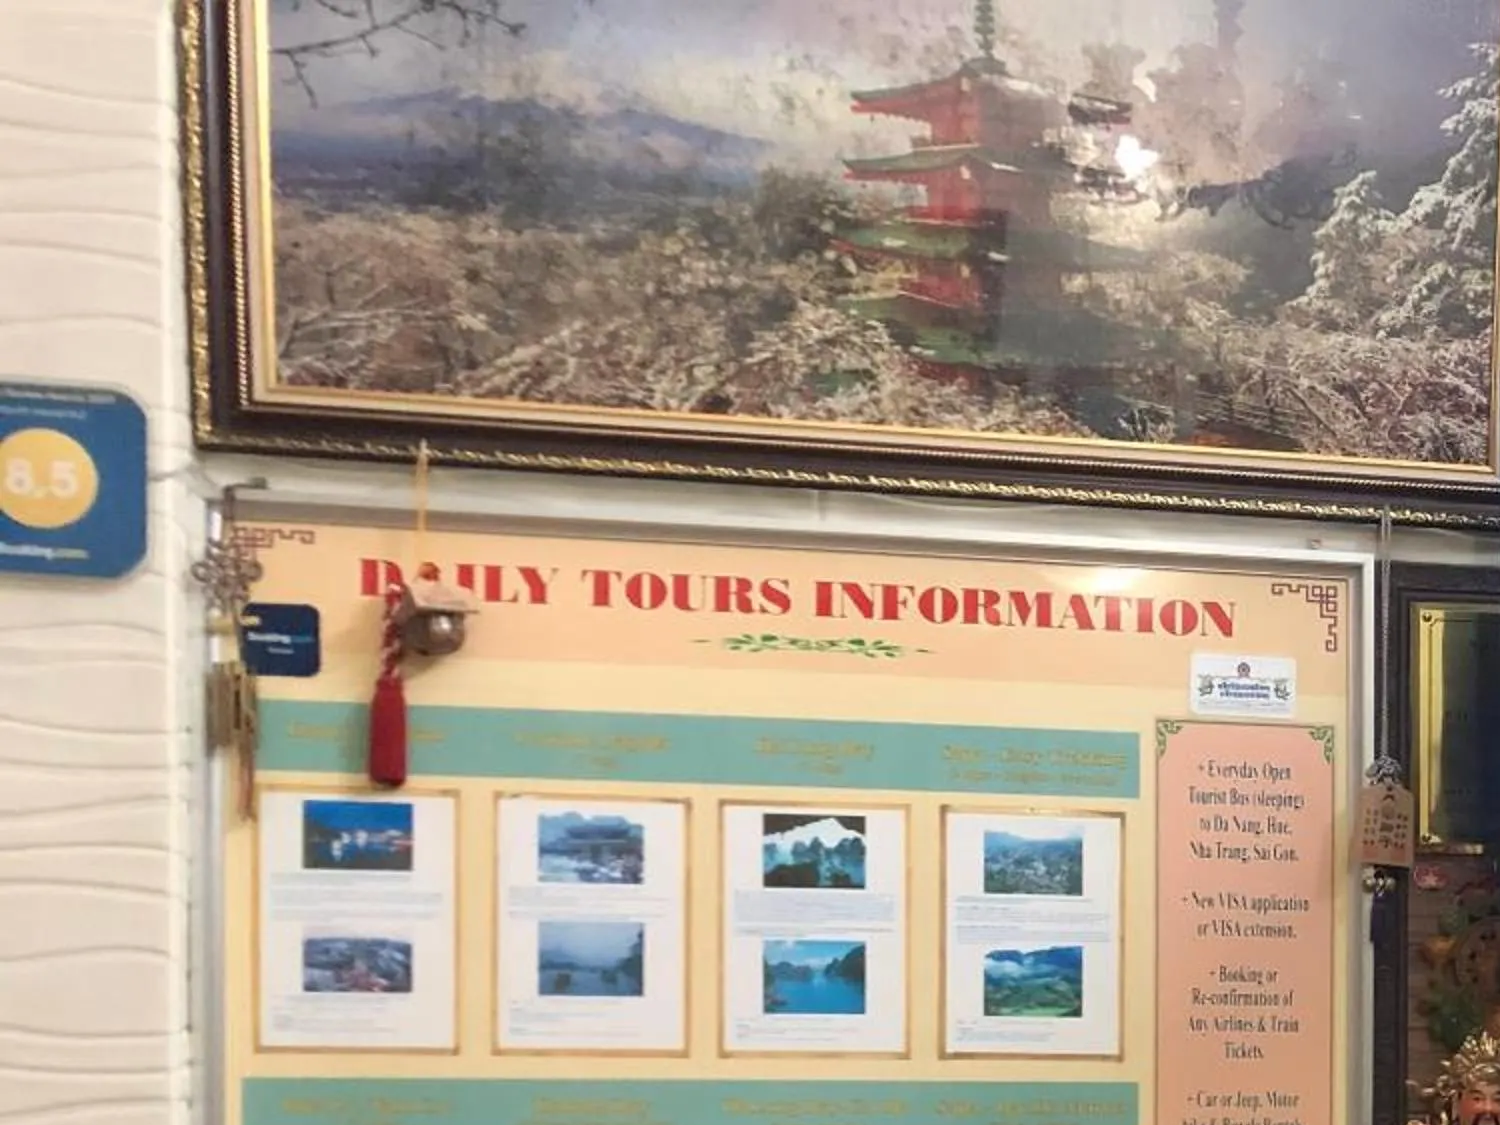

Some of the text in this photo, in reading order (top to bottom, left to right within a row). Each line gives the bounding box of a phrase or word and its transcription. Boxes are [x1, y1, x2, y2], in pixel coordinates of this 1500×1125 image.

[359, 557, 1235, 639] DILY TOURS INFORMATION
[1207, 759, 1291, 785] Everyday Open
[1188, 785, 1305, 810] Tourist Bus (sleeping)
[1200, 817, 1211, 831] to
[1213, 815, 1229, 832] Da
[1189, 841, 1211, 859] Nha
[1253, 844, 1271, 860] Sai
[1192, 891, 1309, 915] New VISA application
[1197, 919, 1297, 939] or VISA extension.
[1219, 964, 1278, 984] Booking or
[1191, 988, 1294, 1007] Re-confirmation of
[1188, 1015, 1299, 1036] Any Airlines & Train
[1197, 1090, 1218, 1108] Car
[1222, 1095, 1233, 1107] or
[1266, 1091, 1300, 1107] Motor
